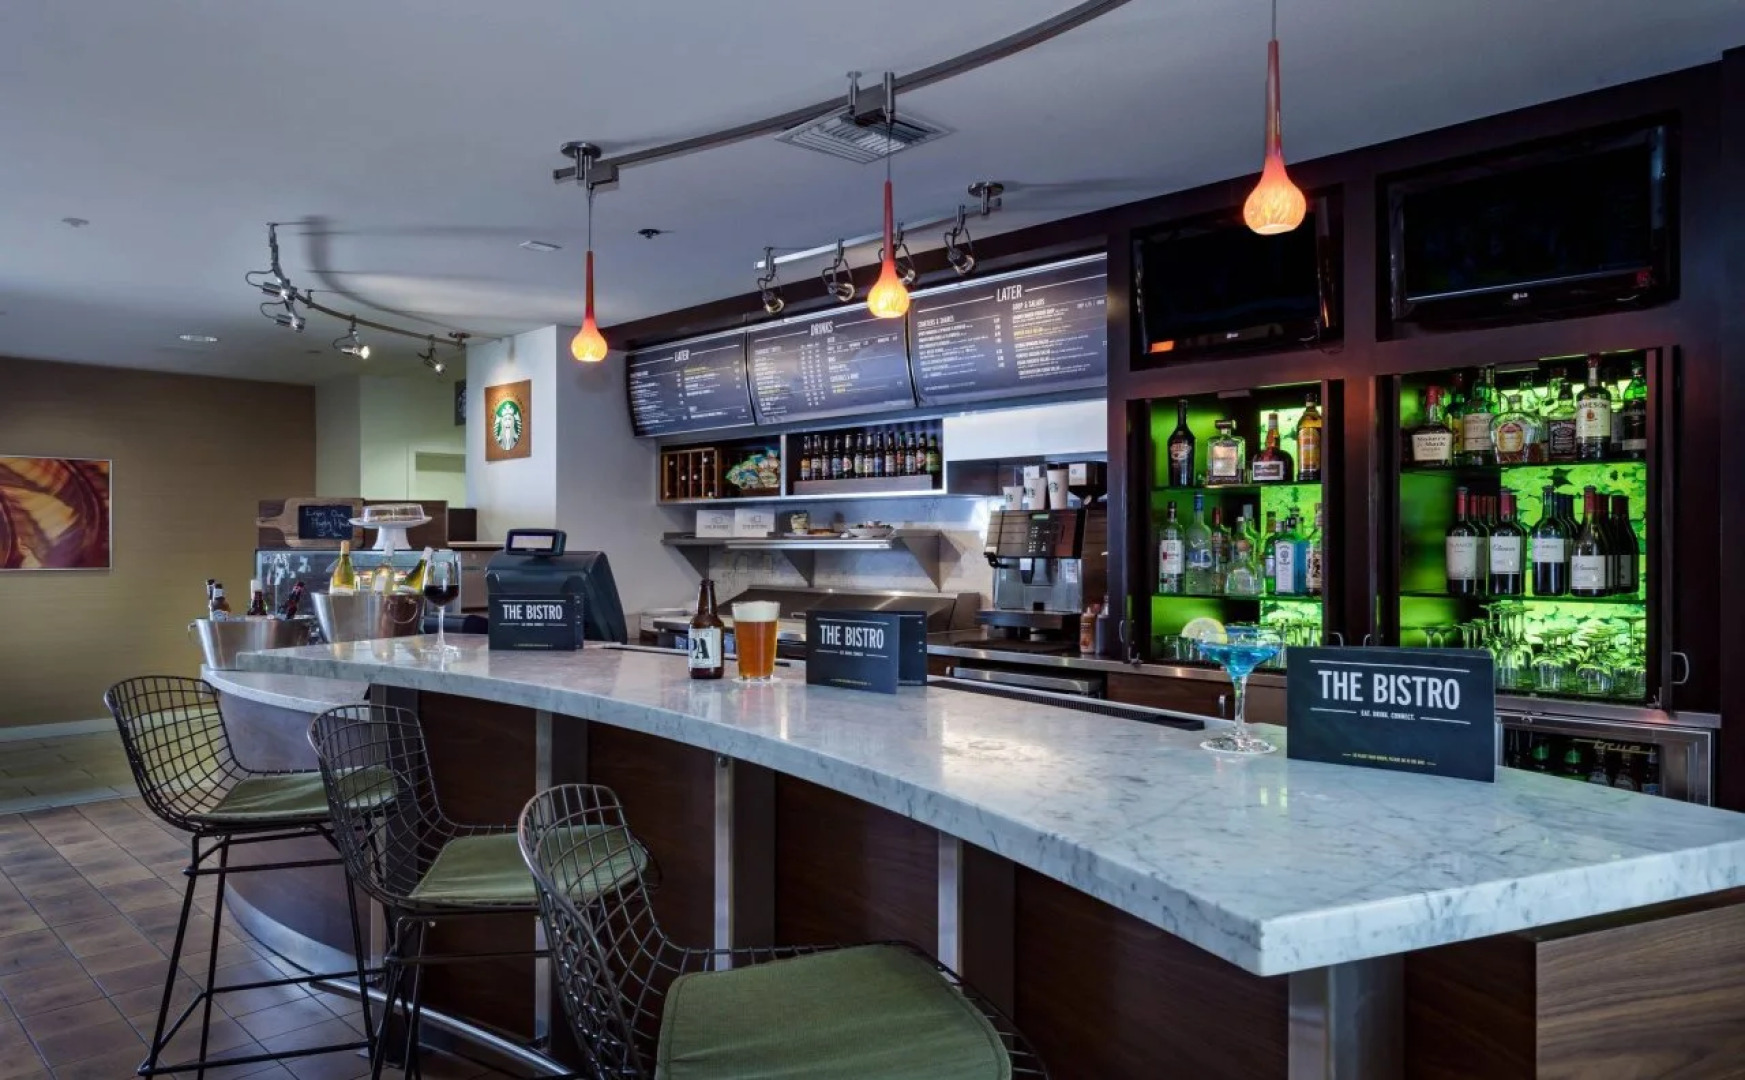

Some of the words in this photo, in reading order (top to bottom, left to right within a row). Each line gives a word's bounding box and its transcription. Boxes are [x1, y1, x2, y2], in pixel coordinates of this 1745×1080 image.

[997, 284, 1022, 302] LATER
[810, 321, 834, 336] DRINKS
[674, 349, 690, 362] LATER
[502, 604, 523, 620] THE
[526, 604, 563, 620] BISTRO
[820, 625, 842, 646] THE
[845, 626, 885, 650] BISTRO
[1317, 670, 1364, 702] THE
[1373, 673, 1461, 710] BISTRO
